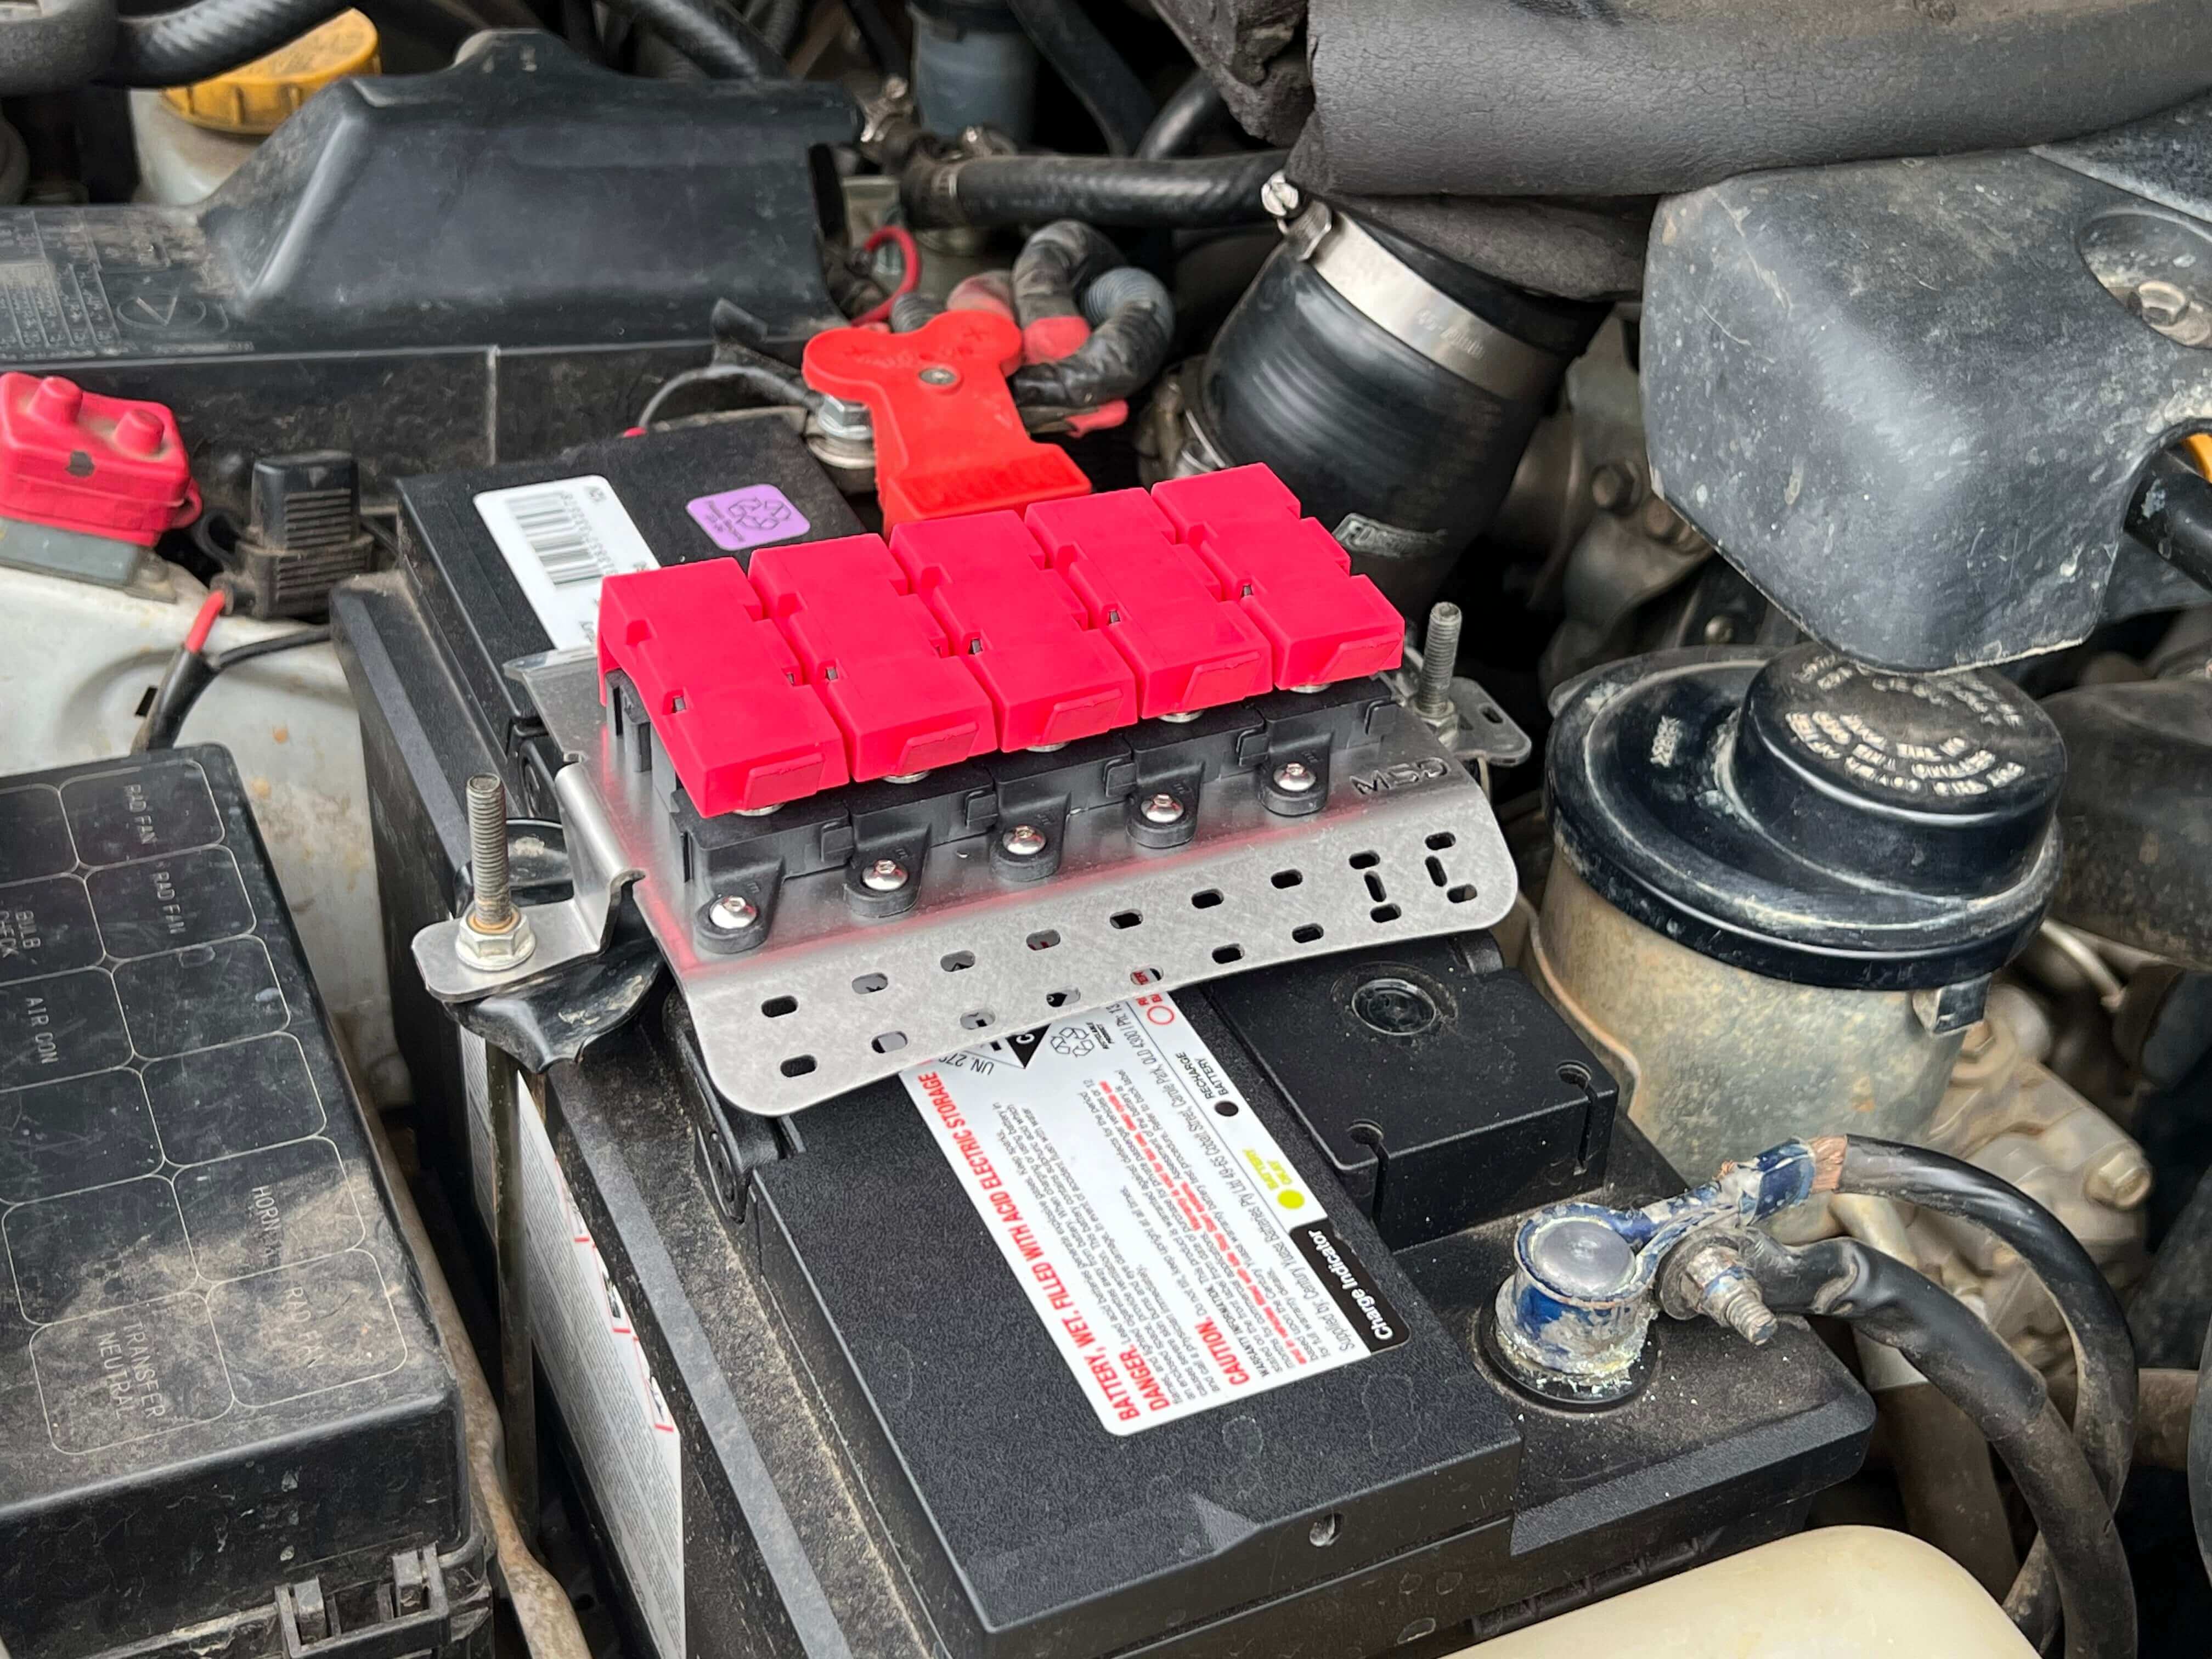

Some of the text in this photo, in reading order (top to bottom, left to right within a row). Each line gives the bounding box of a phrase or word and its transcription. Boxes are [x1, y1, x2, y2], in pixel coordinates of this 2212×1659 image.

[124, 785, 157, 844] RAD FAN
[15, 910, 41, 950] BULB
[151, 871, 187, 933] RAD FAN
[26, 997, 58, 1064] AIR CON
[1175, 1052, 1215, 1099] RECHARGE
[1195, 1058, 1229, 1096] BATTERY
[252, 1185, 282, 1232] HORN
[917, 1071, 1141, 1421] BATTERY, WET. FILLED WITH ACID ELECTRIC STORAGE
[1308, 1231, 1392, 1339] Charge Indicator
[284, 1286, 324, 1369] RAD FAN
[1195, 1317, 1249, 1385] CAUTION.
[98, 1331, 133, 1420] NEUTRAL
[123, 1320, 166, 1419] TRANSFER
[1119, 1345, 1170, 1411] DANGER.
